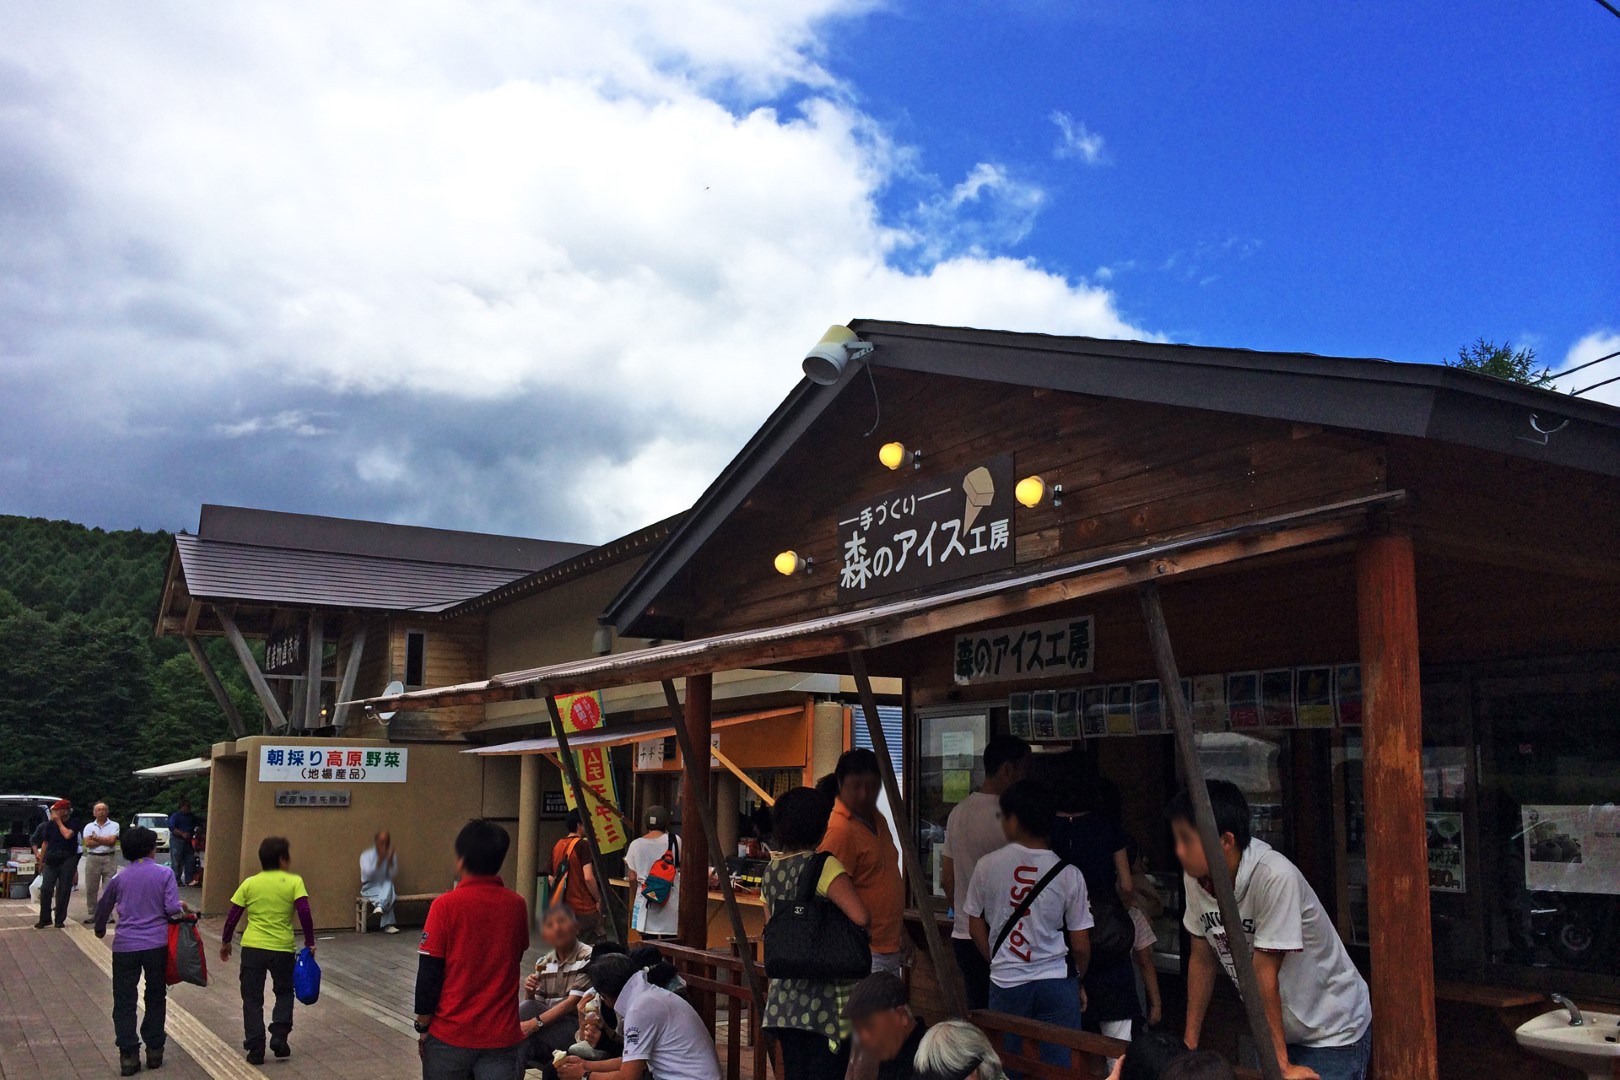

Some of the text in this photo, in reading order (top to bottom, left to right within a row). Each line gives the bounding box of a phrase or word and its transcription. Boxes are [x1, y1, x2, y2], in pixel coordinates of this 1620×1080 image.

[860, 494, 916, 531] 手づくり
[840, 518, 1010, 590] 森のアイス工房
[956, 619, 1090, 677] 森のアイス工房
[267, 749, 401, 768] 朝採り高原野菜
